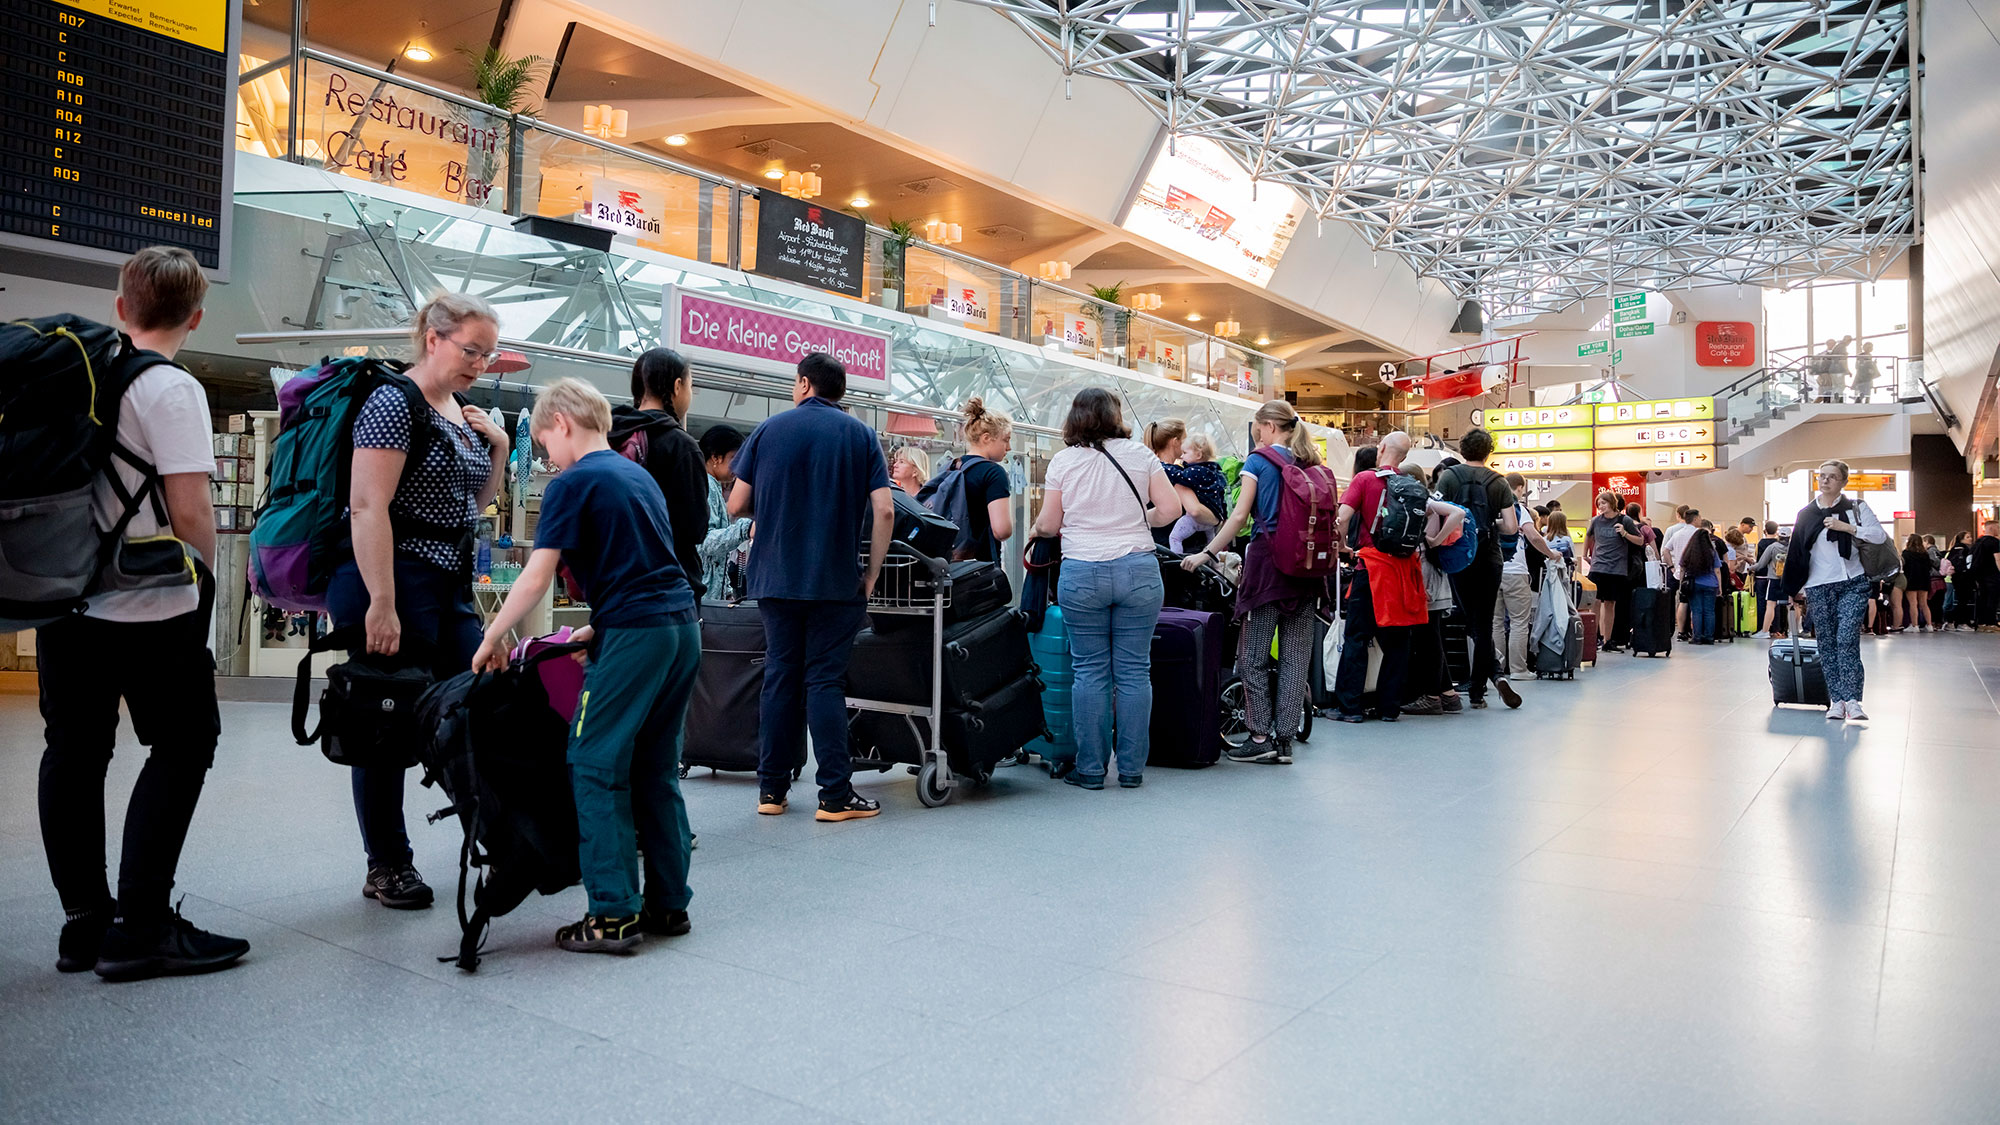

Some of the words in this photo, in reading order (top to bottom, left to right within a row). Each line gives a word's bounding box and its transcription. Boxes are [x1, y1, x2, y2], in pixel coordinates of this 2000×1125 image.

[109, 0, 140, 14] Erwartet
[59, 12, 86, 28] A07
[108, 8, 143, 23] Expected
[149, 12, 198, 32] Bemerkungen
[149, 20, 181, 35] Remarks
[58, 32, 67, 43] C
[58, 51, 67, 62] C
[57, 70, 84, 87] A08
[56, 89, 83, 106] A10
[56, 109, 82, 125] A04
[325, 73, 499, 154] Restaurant
[55, 128, 81, 144] A12
[54, 147, 63, 159] C
[327, 130, 407, 181] Café
[445, 160, 494, 201] Bar
[53, 167, 80, 182] A03
[52, 205, 61, 217] C
[140, 205, 213, 228] cancelled
[598, 203, 622, 223] Red
[625, 210, 660, 234] Baron
[51, 225, 60, 237] E
[794, 217, 810, 233] Red
[811, 222, 834, 240] Baron
[778, 231, 801, 245] Airport
[786, 245, 797, 254] bis
[811, 250, 822, 260] Uhr
[823, 252, 842, 264] täglich
[778, 252, 801, 266] inklusive
[826, 266, 838, 275] oder
[838, 267, 849, 277] Tee
[951, 299, 965, 314] Red
[965, 303, 987, 320] Baron
[1619, 309, 1641, 318] Bangkok
[1619, 324, 1651, 333] Doha/Qatar
[688, 308, 720, 340] Die
[726, 316, 778, 351] kleine
[784, 330, 881, 371] Gesellschaft
[1591, 341, 1605, 349] YORK
[1657, 430, 1665, 440] B
[1679, 429, 1688, 438] C
[1507, 460, 1515, 468] A
[1517, 459, 1534, 469] 0-8
